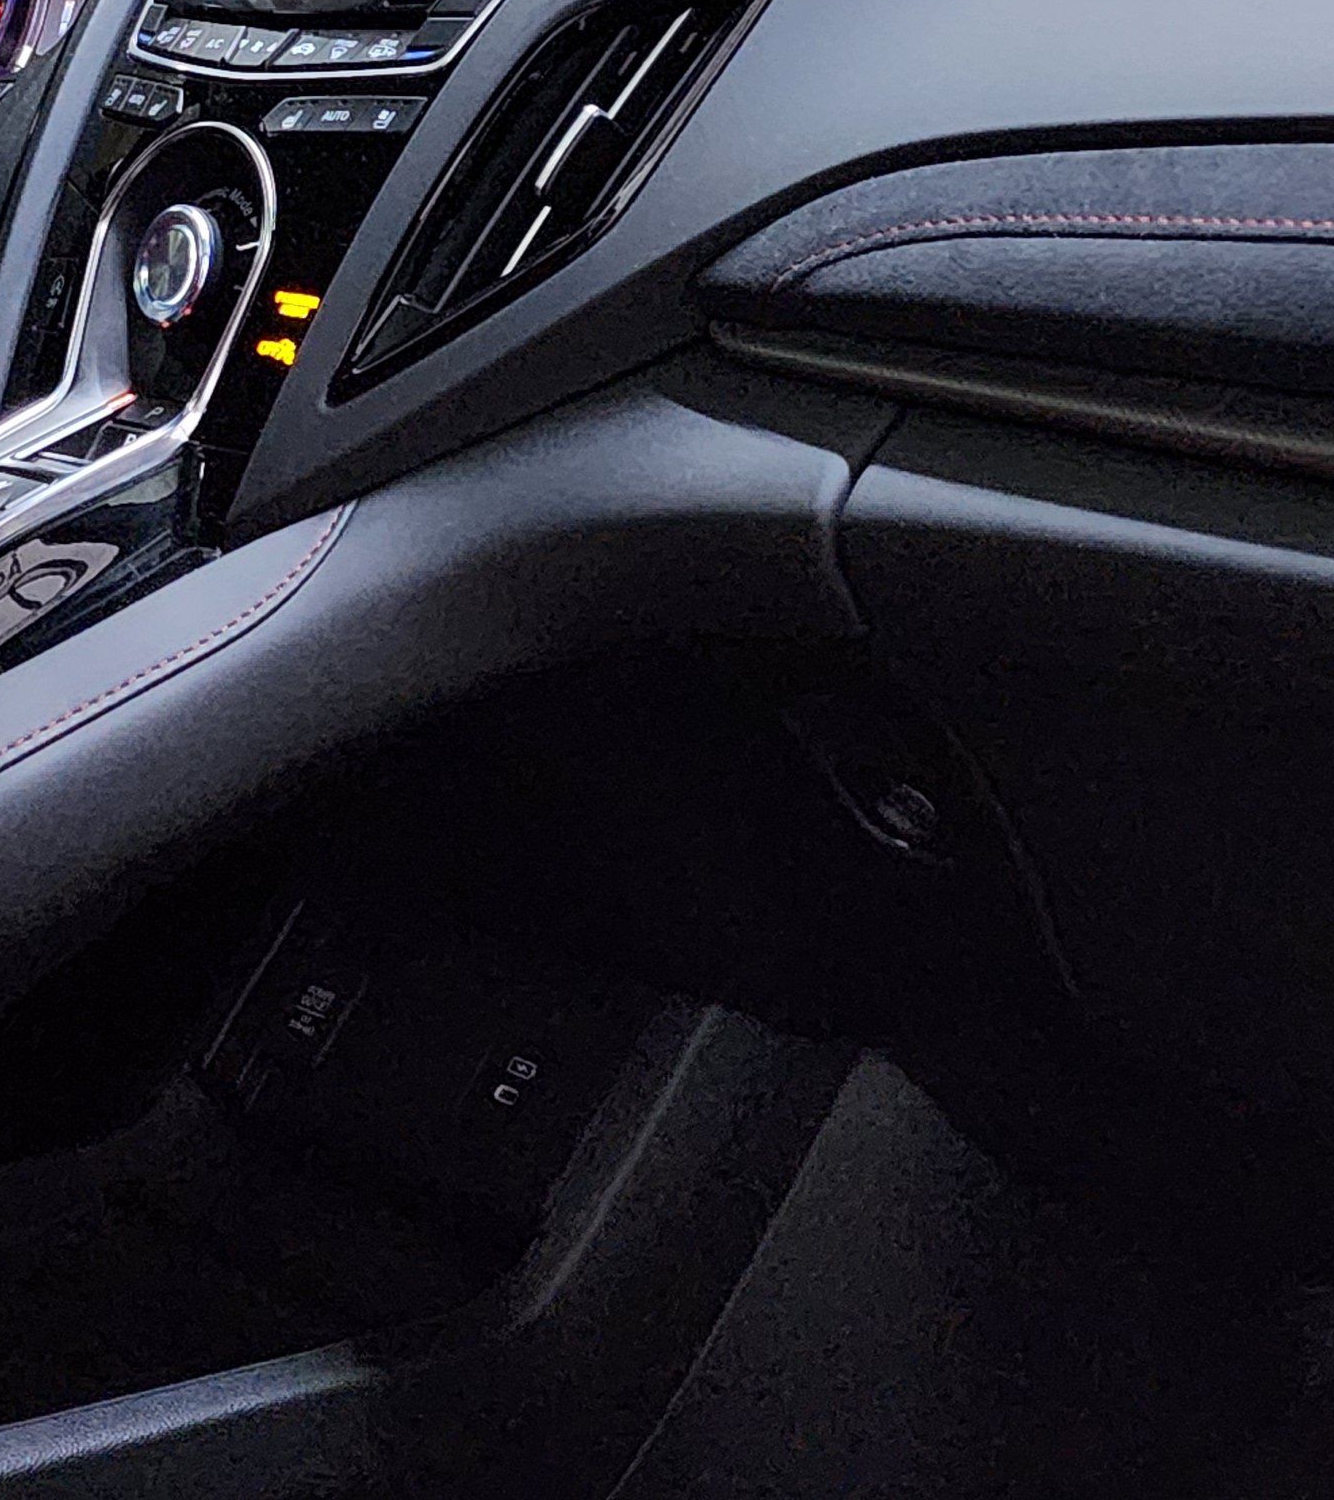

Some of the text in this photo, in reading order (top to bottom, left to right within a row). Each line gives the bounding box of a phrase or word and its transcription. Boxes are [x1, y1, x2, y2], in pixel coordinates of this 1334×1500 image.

[320, 110, 351, 122] AUTO
[228, 187, 254, 217] Mode
[144, 405, 165, 420] P
